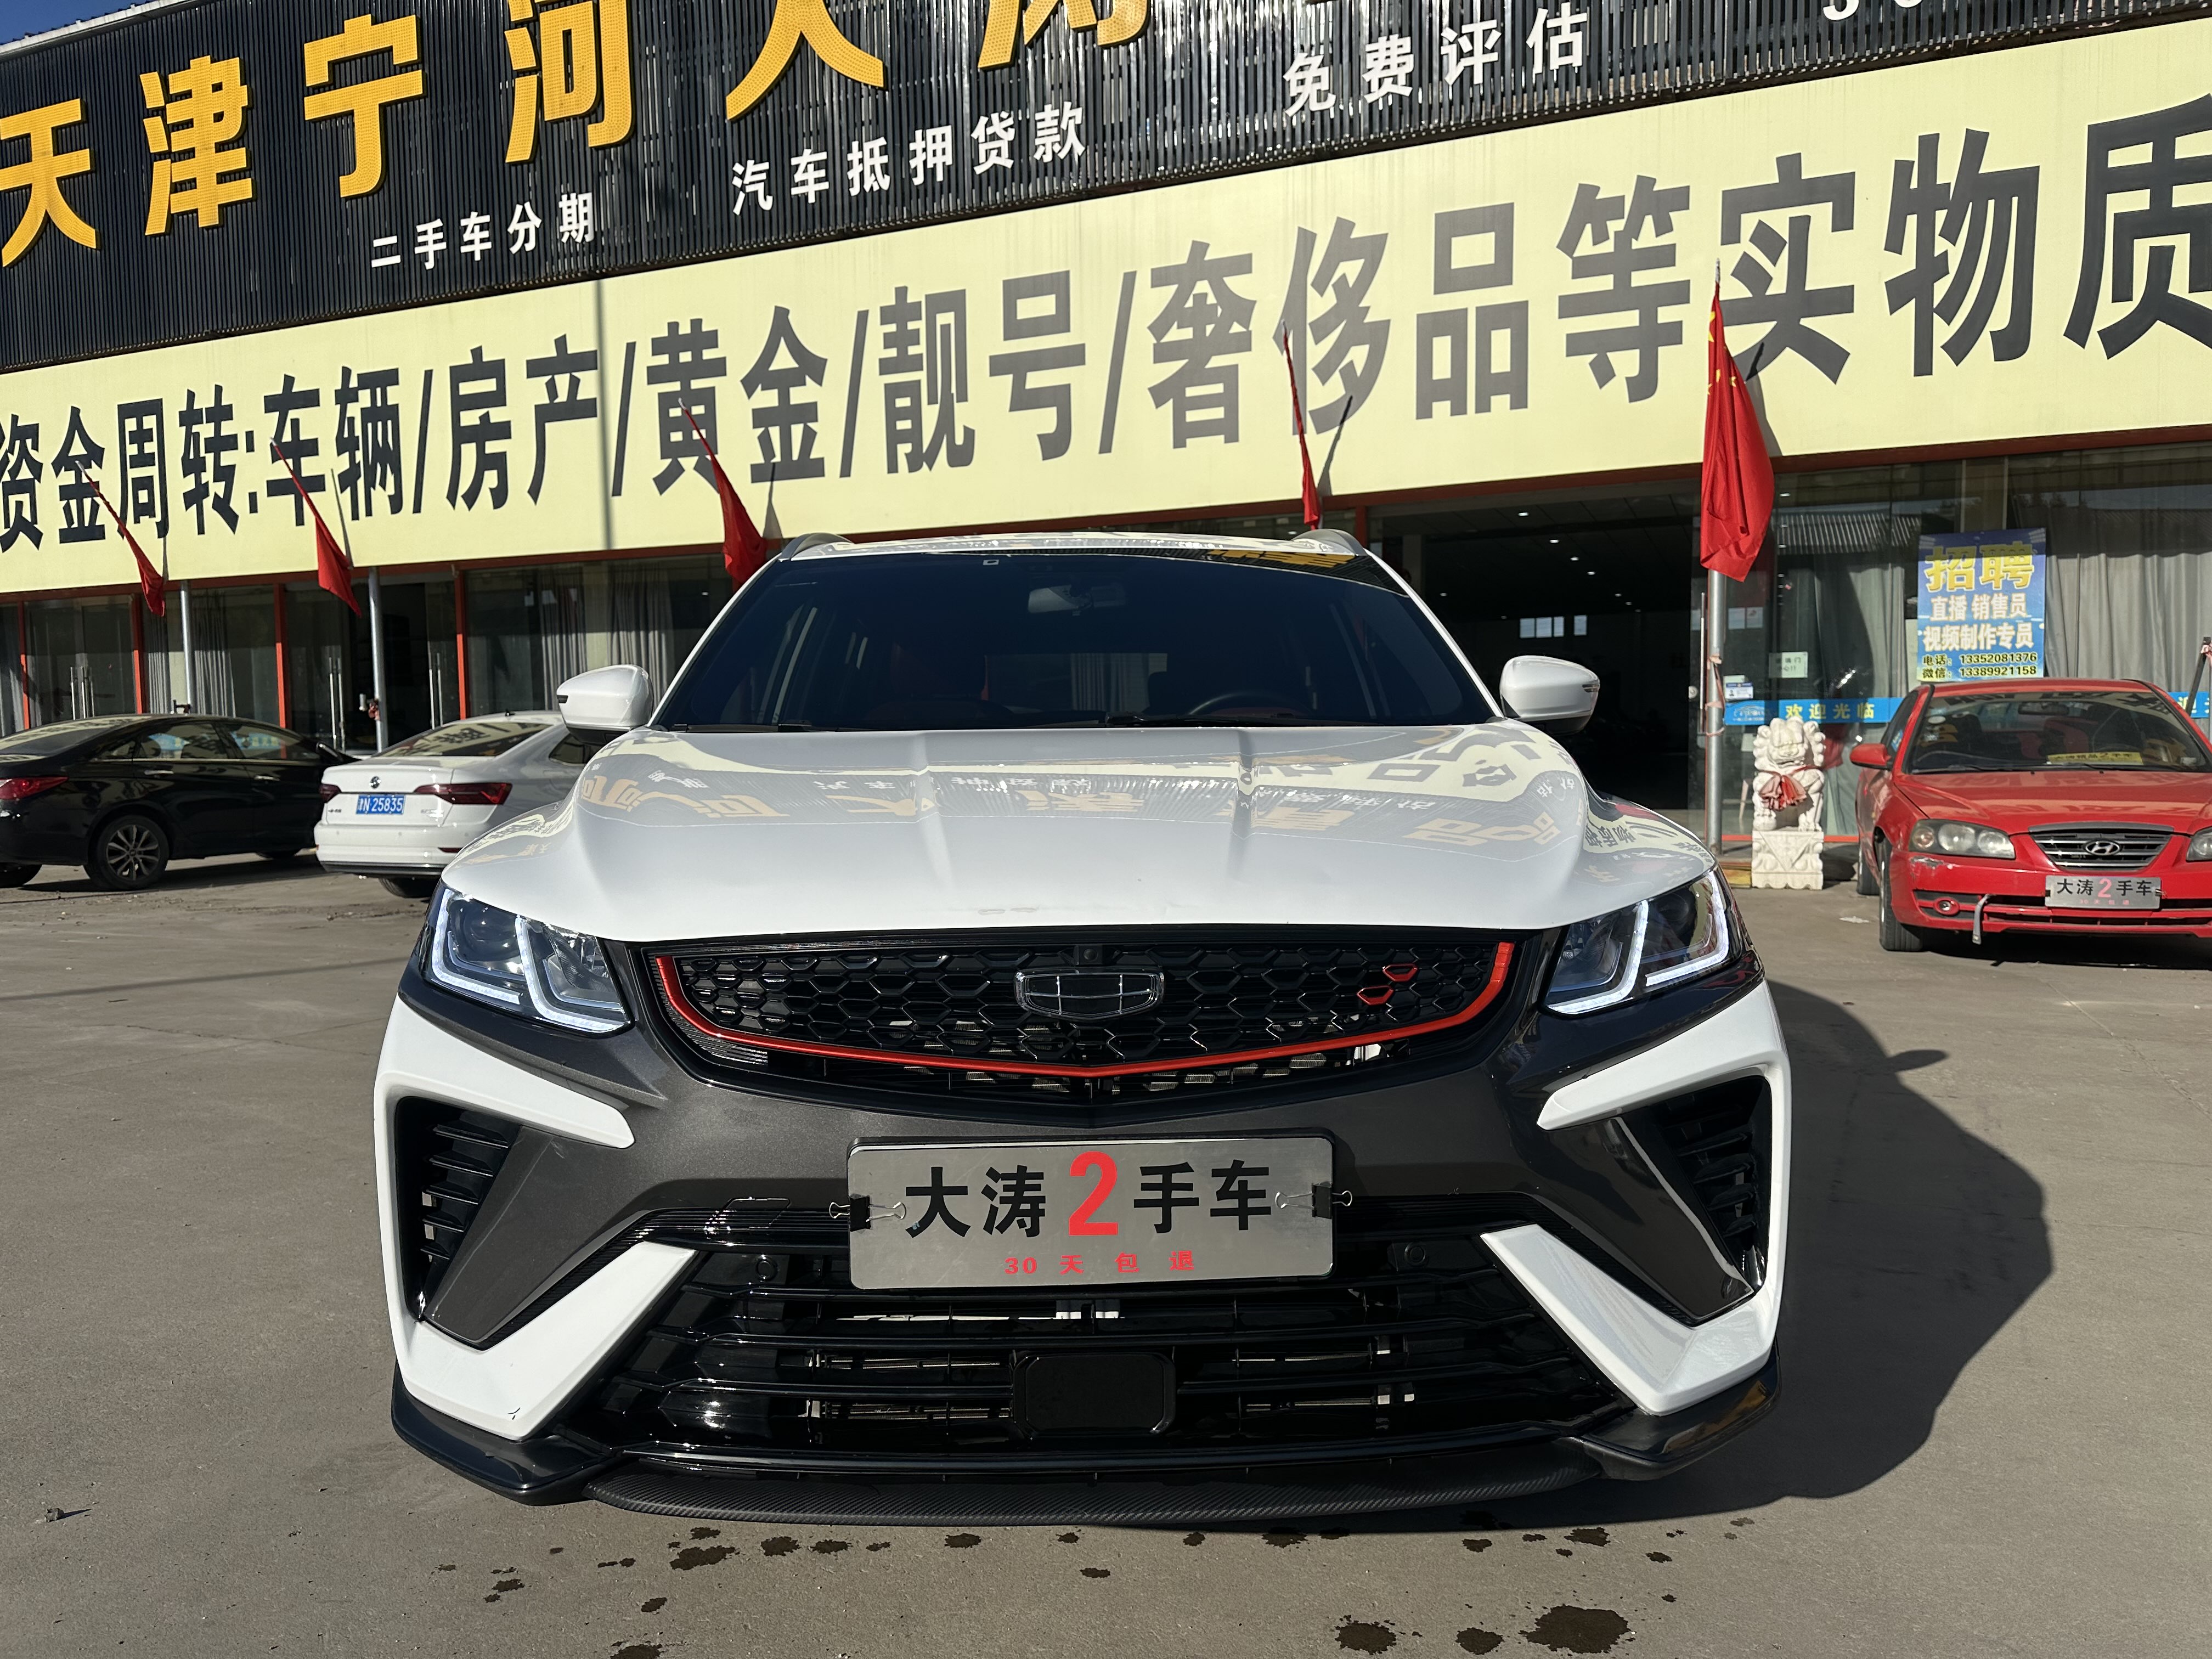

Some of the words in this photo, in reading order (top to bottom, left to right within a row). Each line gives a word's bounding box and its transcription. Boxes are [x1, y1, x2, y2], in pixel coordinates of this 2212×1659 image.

[1283, 1, 1589, 117] 免费评估
[732, 101, 1086, 216] 汽车抵押贷款
[371, 193, 593, 269] 二手车分期
[1923, 541, 2034, 592] 招聘
[1922, 622, 2034, 652] 视频制作专员
[1960, 652, 2037, 664] 13352081376
[1960, 665, 2036, 677] 13389921158
[1785, 703, 1875, 719] 欢迎光临
[2057, 878, 2152, 898] 大涛2手车
[904, 1151, 1272, 1238] 大涛2手车
[1005, 1250, 1195, 1274] 30天包退
